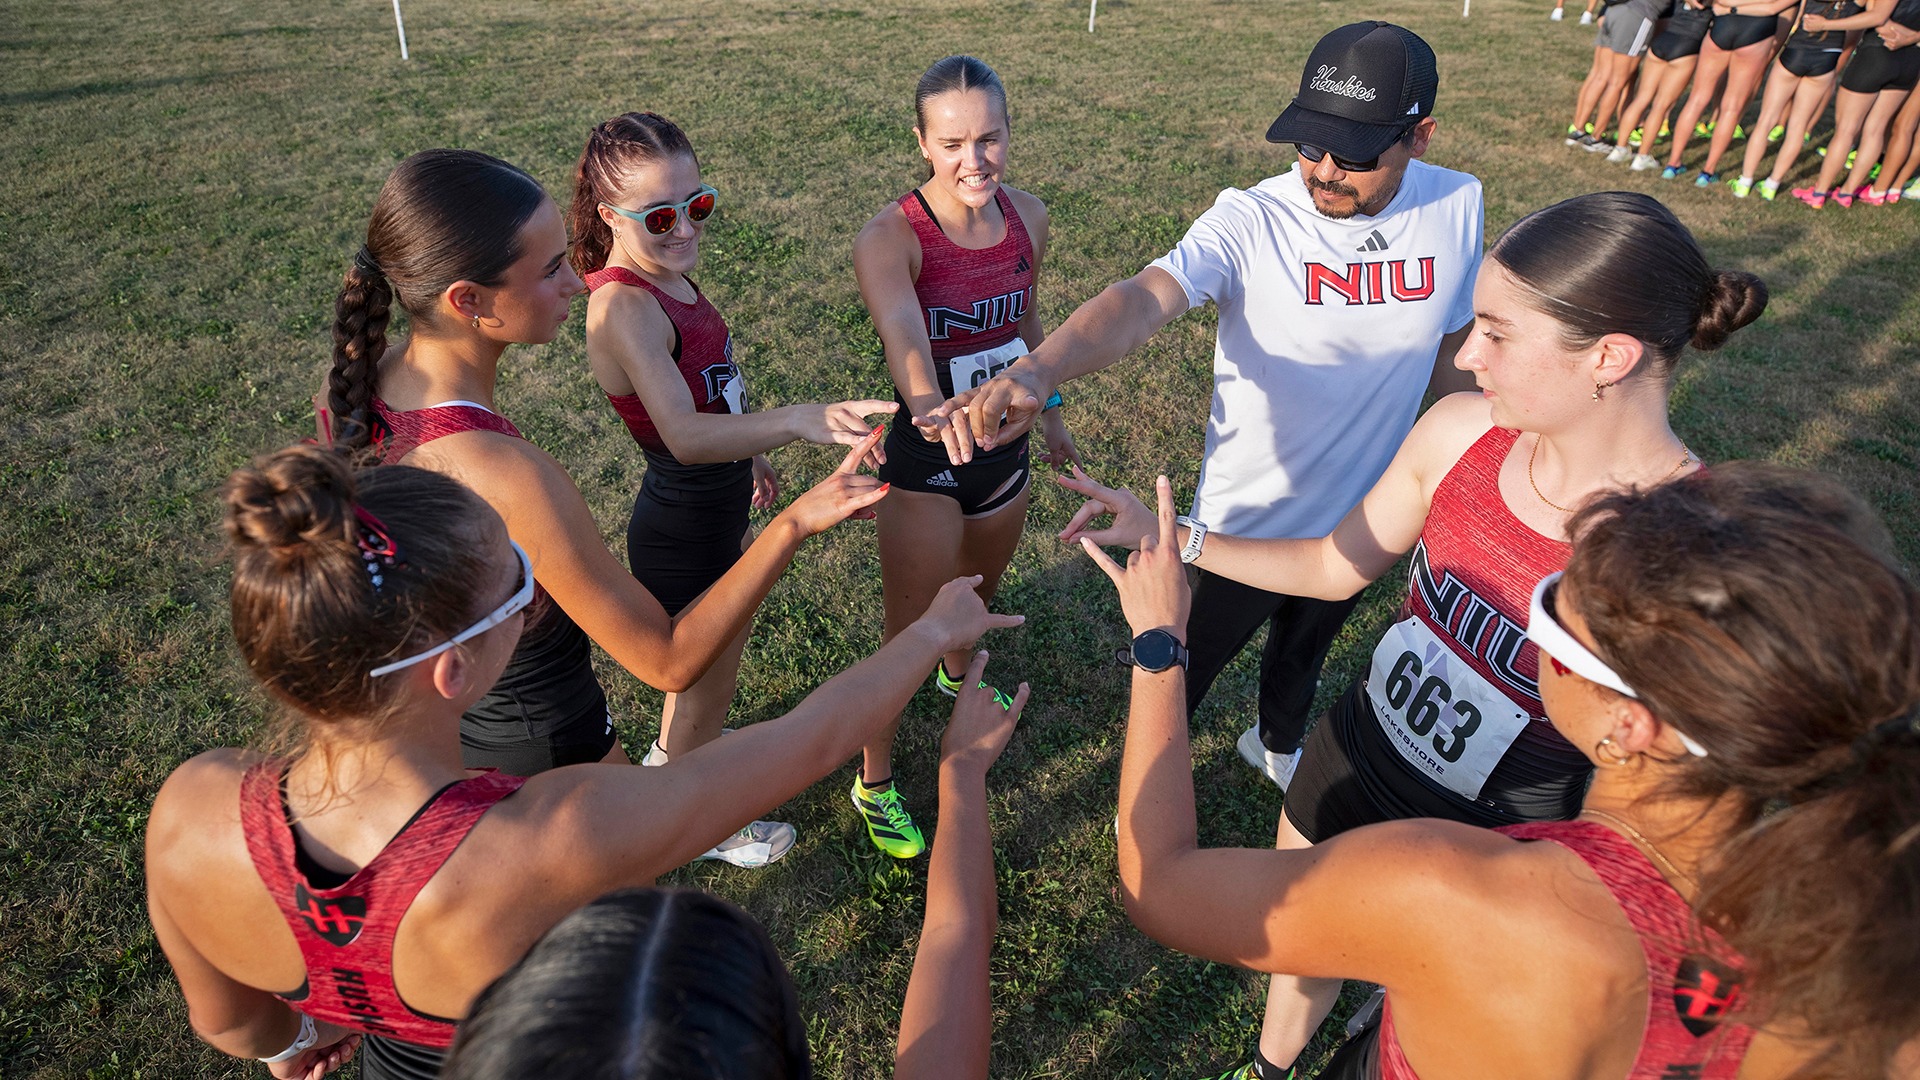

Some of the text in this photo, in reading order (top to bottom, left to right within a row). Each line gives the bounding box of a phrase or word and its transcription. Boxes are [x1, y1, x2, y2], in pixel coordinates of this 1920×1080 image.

[1309, 64, 1377, 102] Huskies
[1303, 255, 1435, 306] NIU
[927, 285, 1033, 340] NIU
[926, 478, 959, 488] adidas
[1385, 650, 1483, 763] 663
[1380, 705, 1445, 775] LAKESHORE
